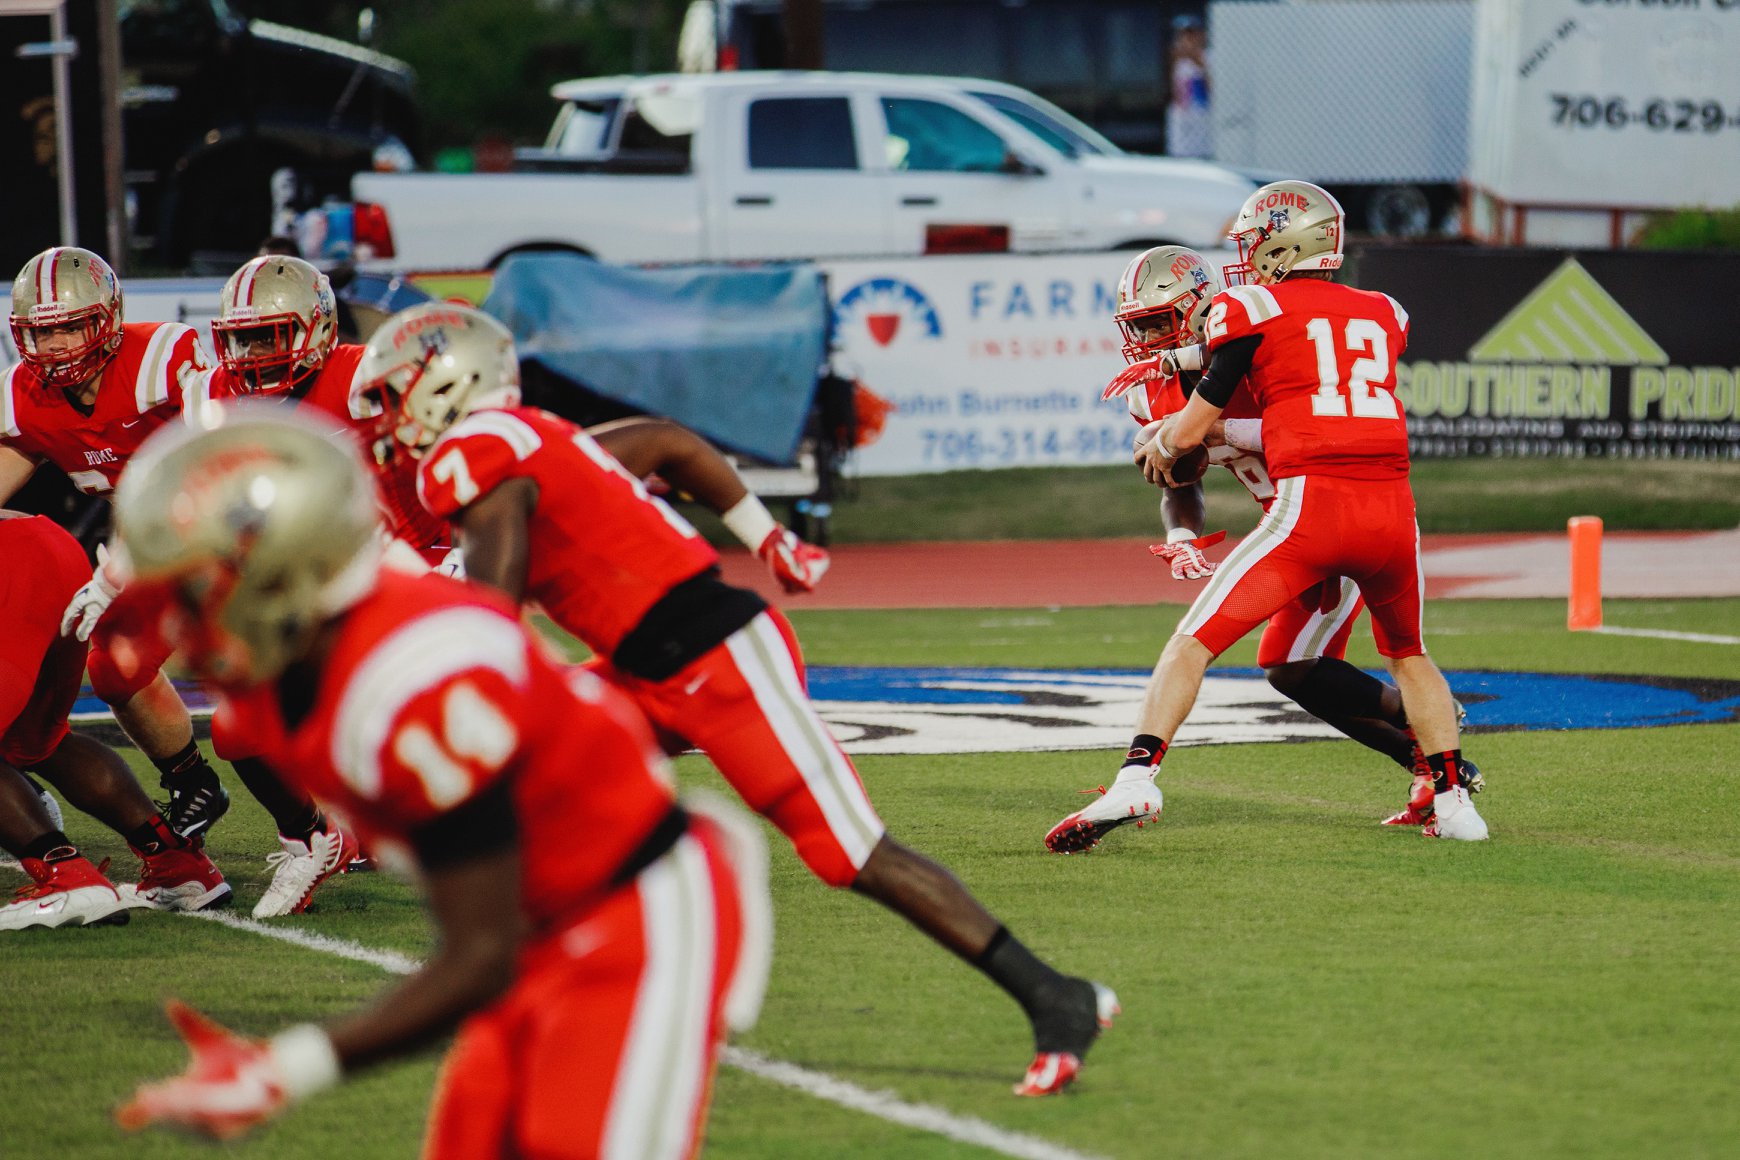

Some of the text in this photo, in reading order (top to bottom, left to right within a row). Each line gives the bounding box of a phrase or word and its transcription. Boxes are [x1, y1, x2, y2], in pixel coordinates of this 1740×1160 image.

[1255, 192, 1308, 218] ROME
[1326, 227, 1335, 237] 12
[1170, 254, 1199, 283] ROM
[36, 304, 58, 313] Riddell
[1306, 318, 1399, 419] 12
[1629, 366, 1740, 421] PRID
[83, 448, 118, 465] ROME
[432, 447, 480, 506] 7
